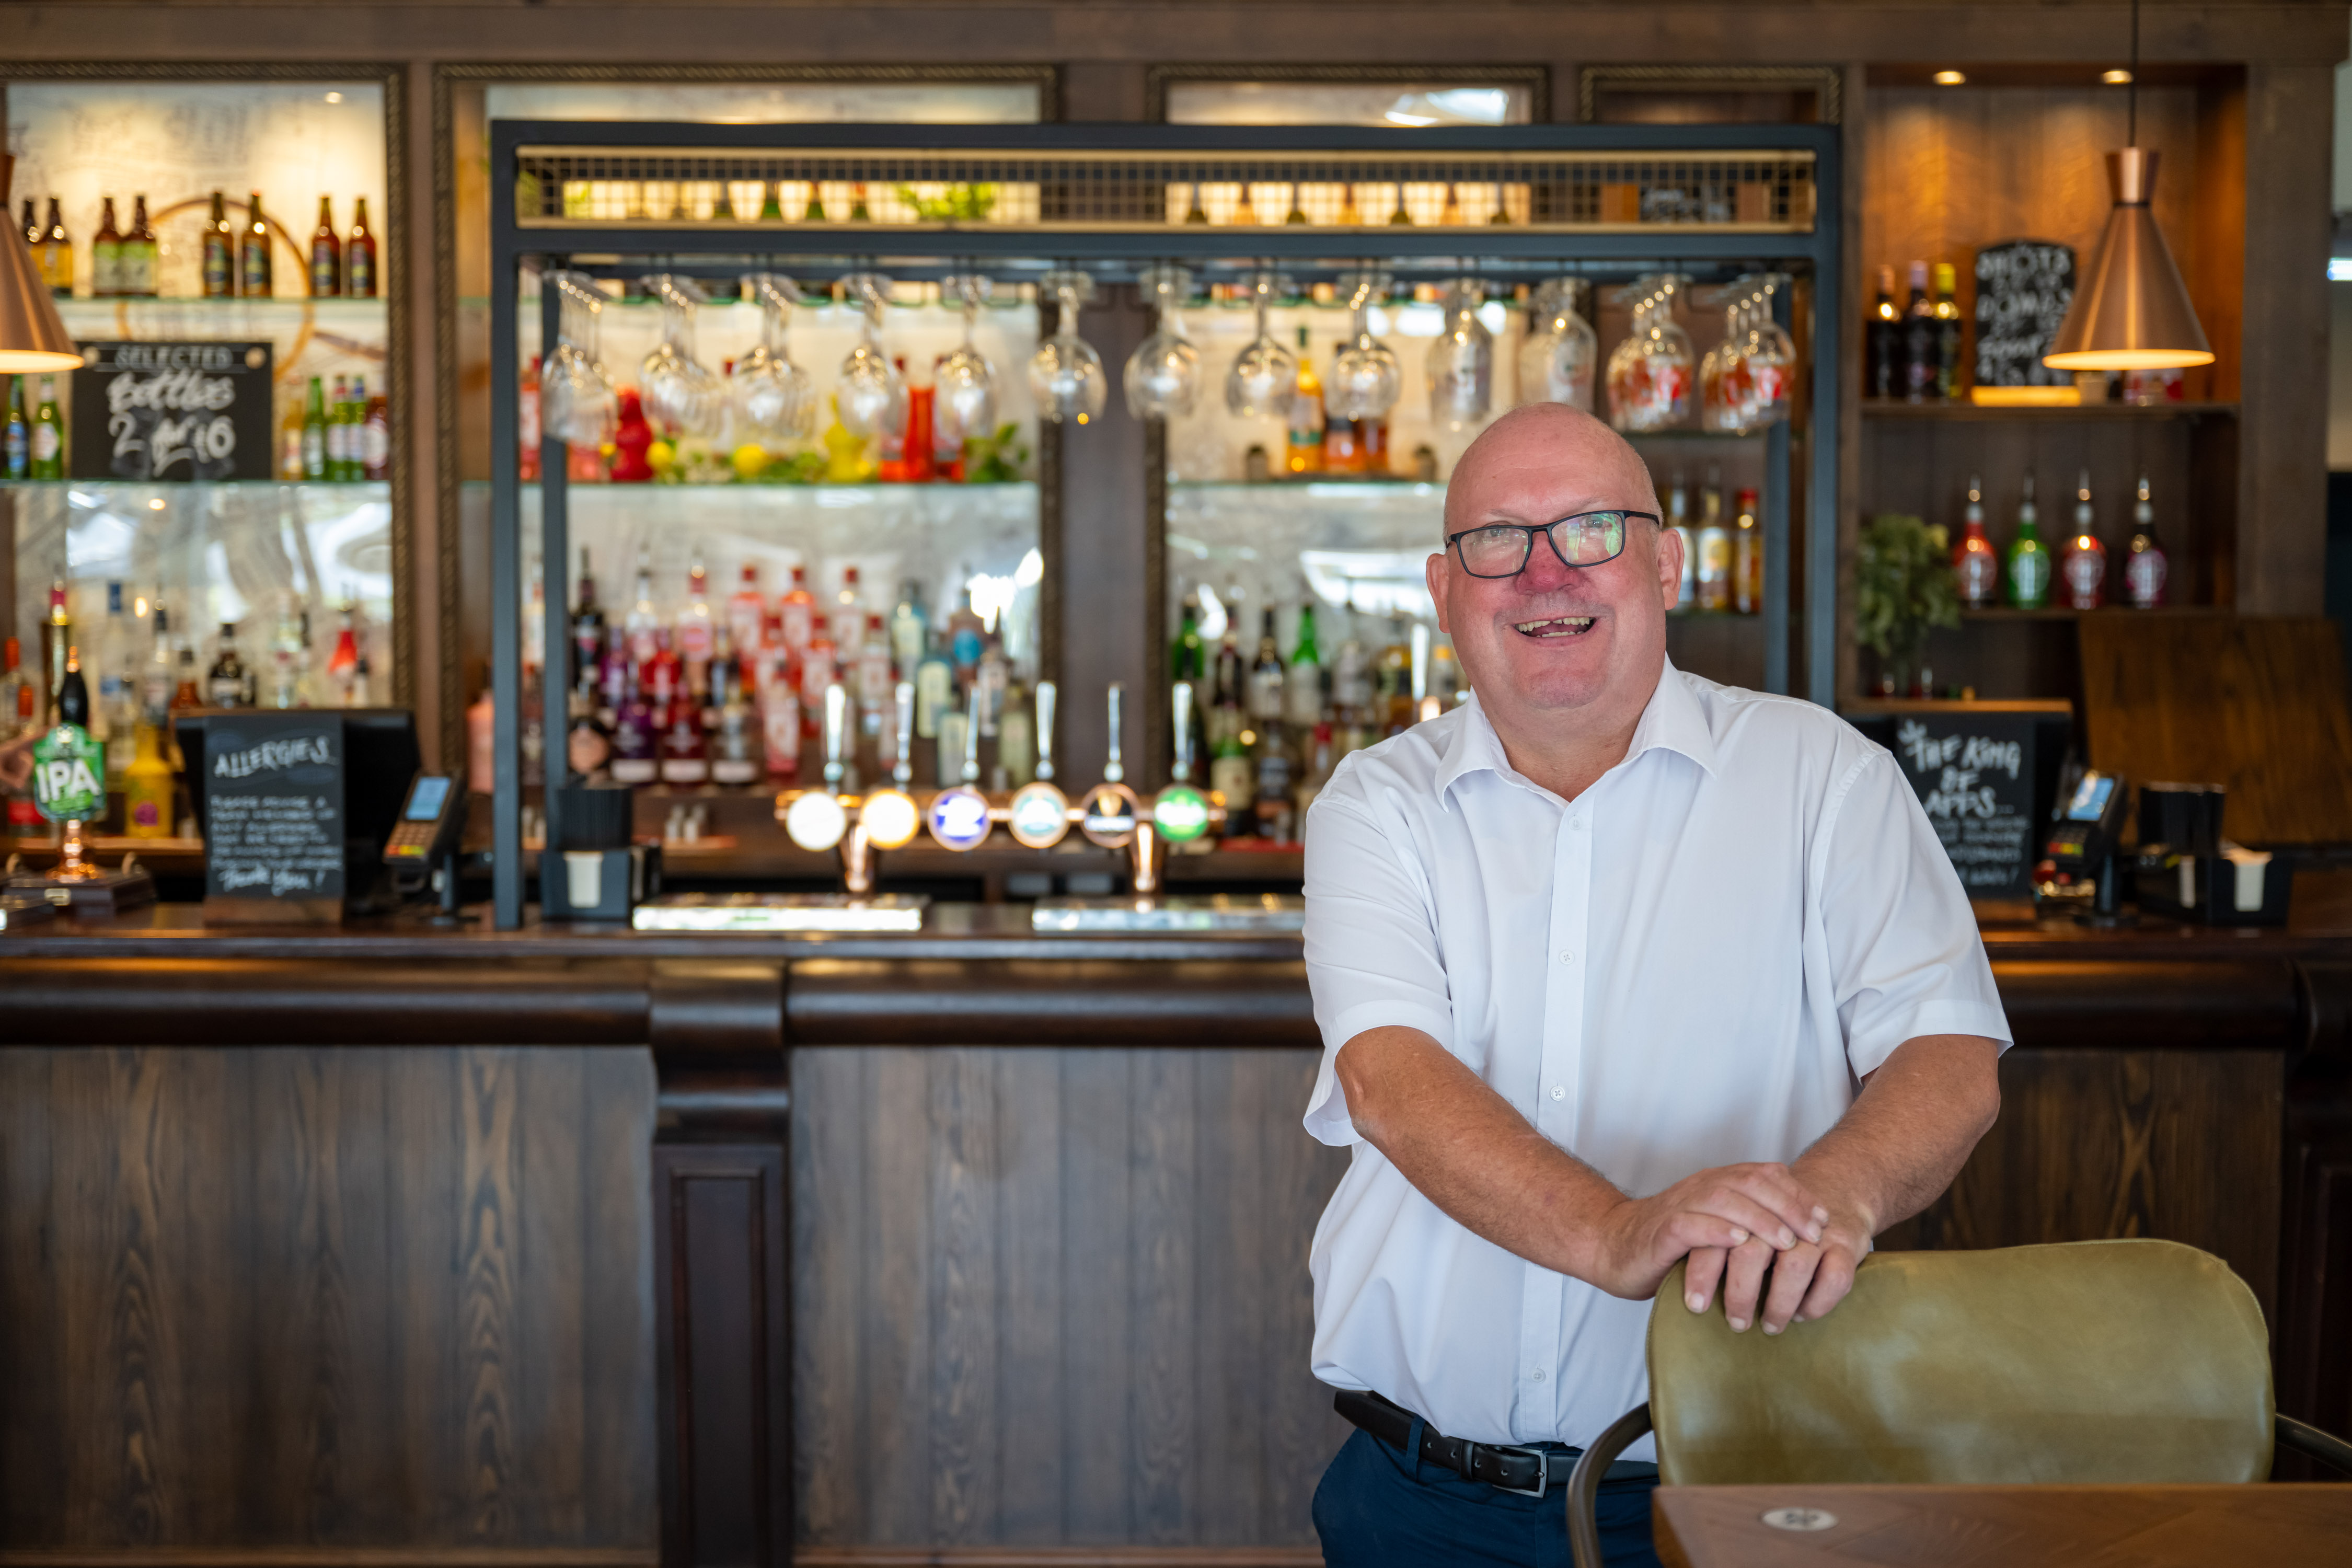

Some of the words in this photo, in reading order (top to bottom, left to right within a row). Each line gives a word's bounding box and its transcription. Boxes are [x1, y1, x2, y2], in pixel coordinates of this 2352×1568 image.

[114, 344, 234, 370] SELECTED
[108, 411, 146, 458] 2
[36, 758, 101, 803] IPA
